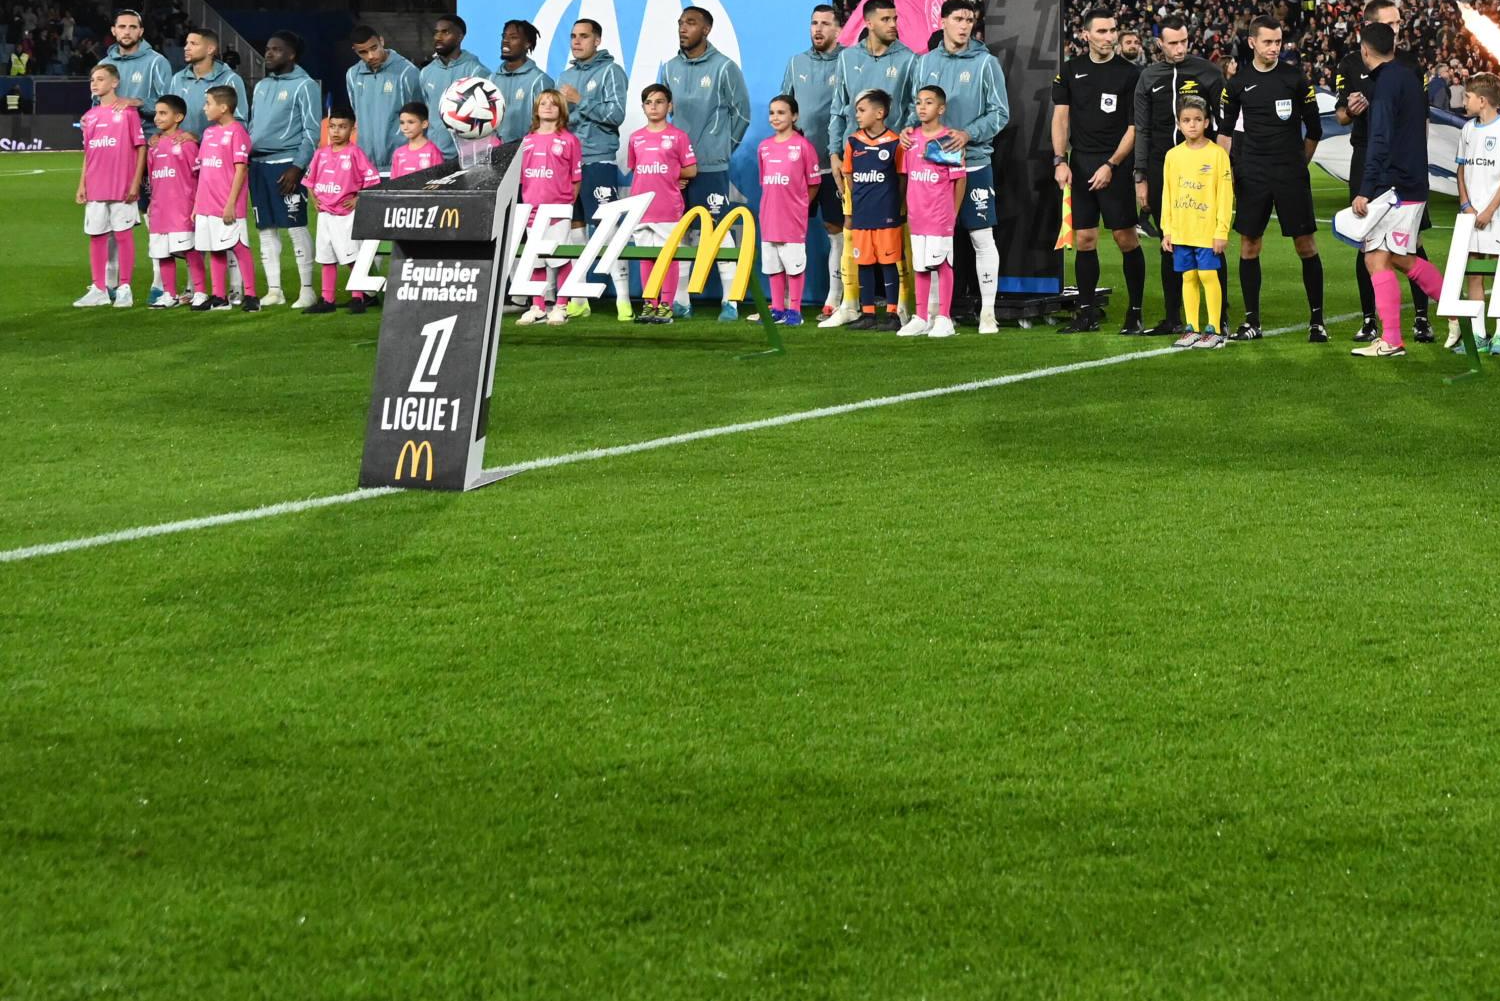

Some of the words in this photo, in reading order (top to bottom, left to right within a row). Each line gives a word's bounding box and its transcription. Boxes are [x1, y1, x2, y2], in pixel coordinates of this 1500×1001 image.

[89, 136, 117, 149] swile
[636, 162, 669, 175] swile
[1476, 158, 1495, 167] CGM
[524, 165, 554, 179] swile
[853, 171, 885, 184] swile
[911, 169, 940, 184] swile
[315, 181, 342, 195] swile
[384, 207, 423, 229] LIGUE
[400, 258, 480, 283] Équipier
[397, 284, 419, 300] du
[422, 284, 478, 302] match
[381, 396, 447, 432] LIGUE
[450, 398, 460, 431] 1
